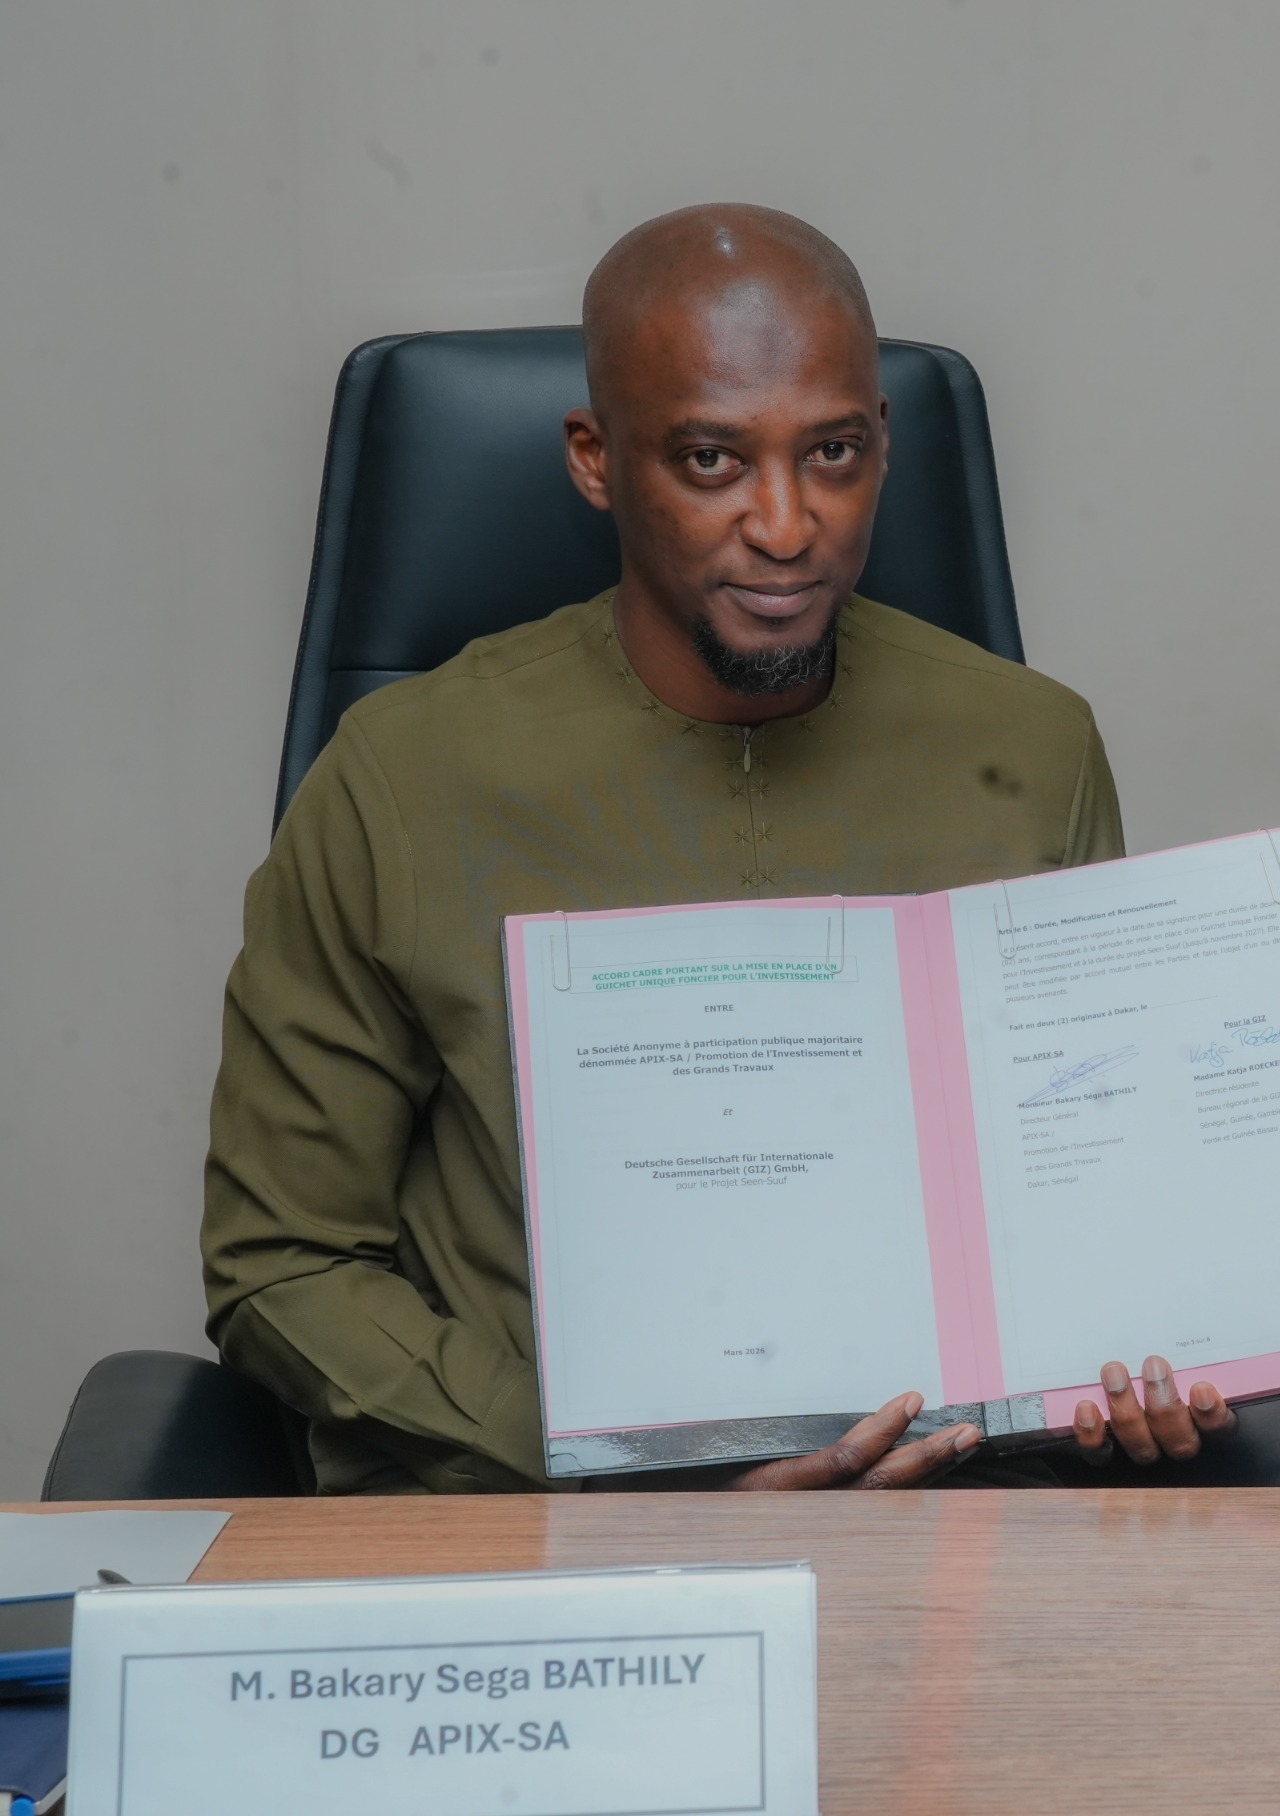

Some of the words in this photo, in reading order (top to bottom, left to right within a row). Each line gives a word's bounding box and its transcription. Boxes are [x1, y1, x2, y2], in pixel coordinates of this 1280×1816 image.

[592, 971, 630, 980] ACCORD
[632, 968, 663, 977] CADRE
[665, 965, 708, 974] PORTANT
[711, 964, 730, 972] SUR
[595, 980, 636, 990] GUICHET
[639, 977, 675, 986] UNIQUE
[678, 974, 719, 983] FONCIER
[750, 971, 837, 980] L'INVESTISSEMENT
[704, 1004, 734, 1012] ENTRE
[1224, 1019, 1242, 1029] Pour
[1251, 1014, 1267, 1025] GIZ
[591, 1043, 629, 1054] Société
[632, 1042, 681, 1051] Anonyme
[693, 1037, 758, 1050] participation
[760, 1036, 805, 1046] publique
[807, 1035, 862, 1045] majoritaire
[579, 1056, 636, 1068] dénommée
[639, 1054, 683, 1064] APIX-SA
[695, 1051, 748, 1061] Promotion
[751, 1050, 763, 1058] de
[766, 1048, 849, 1057] l'Investissement
[852, 1048, 862, 1056] et
[1013, 1054, 1031, 1064] Pour
[1032, 1049, 1064, 1062] APIX-SA
[672, 1067, 690, 1075] des
[693, 1064, 729, 1074] Grands
[732, 1064, 774, 1072] Travaux
[1193, 1071, 1225, 1081] Madame
[1226, 1067, 1247, 1075] Katja
[722, 1108, 733, 1116] Et
[624, 1159, 673, 1168] Deutsche
[676, 1154, 739, 1165] Gesellschaft
[742, 1153, 757, 1162] für
[760, 1151, 833, 1161] Internationale
[652, 1166, 740, 1179] Zusammenarbeit
[743, 1164, 771, 1176] (GIZ)
[774, 1163, 808, 1173] GmbH,
[676, 1182, 697, 1191] pour
[699, 1180, 708, 1188] le
[711, 1178, 738, 1189] Projet
[740, 1176, 787, 1186] Seen-Suuf
[745, 1347, 766, 1355] 2026
[230, 1670, 275, 1701] M.
[290, 1667, 425, 1702] Bakary
[436, 1663, 530, 1699] Sega
[544, 1653, 705, 1689] BATHILY
[320, 1727, 379, 1759] DG
[408, 1720, 570, 1756] APIX-SA
